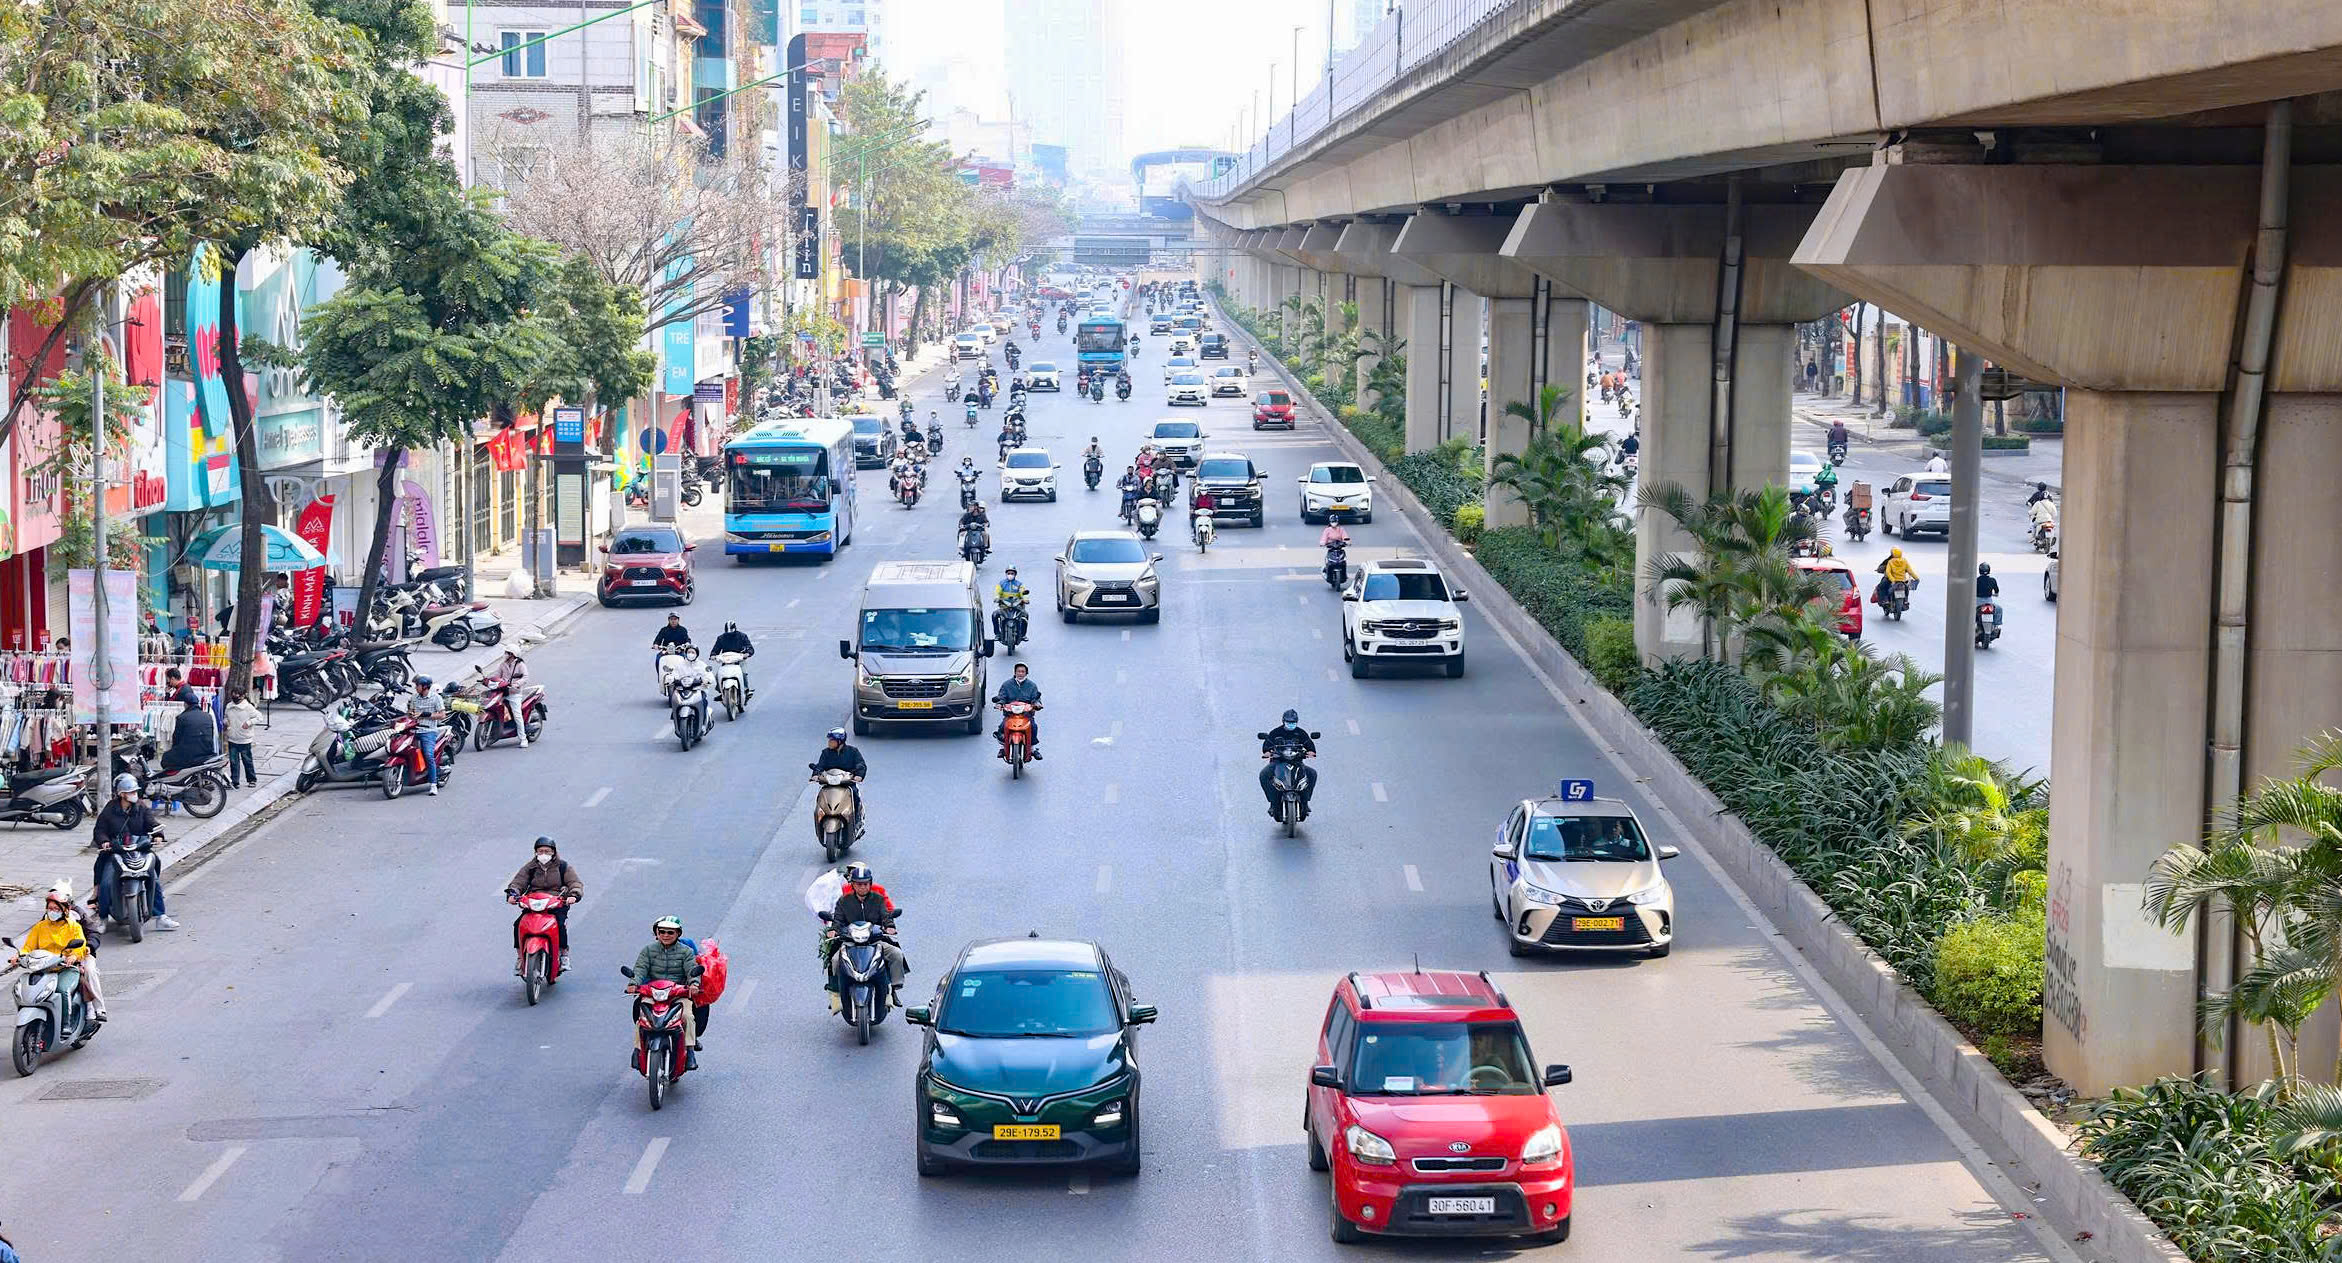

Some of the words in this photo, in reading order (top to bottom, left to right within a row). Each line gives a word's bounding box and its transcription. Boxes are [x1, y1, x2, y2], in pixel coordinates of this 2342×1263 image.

[1569, 781, 1588, 799] G7
[1000, 1128, 1055, 1137] 29E-179.52
[1451, 1143, 1469, 1151] KIA
